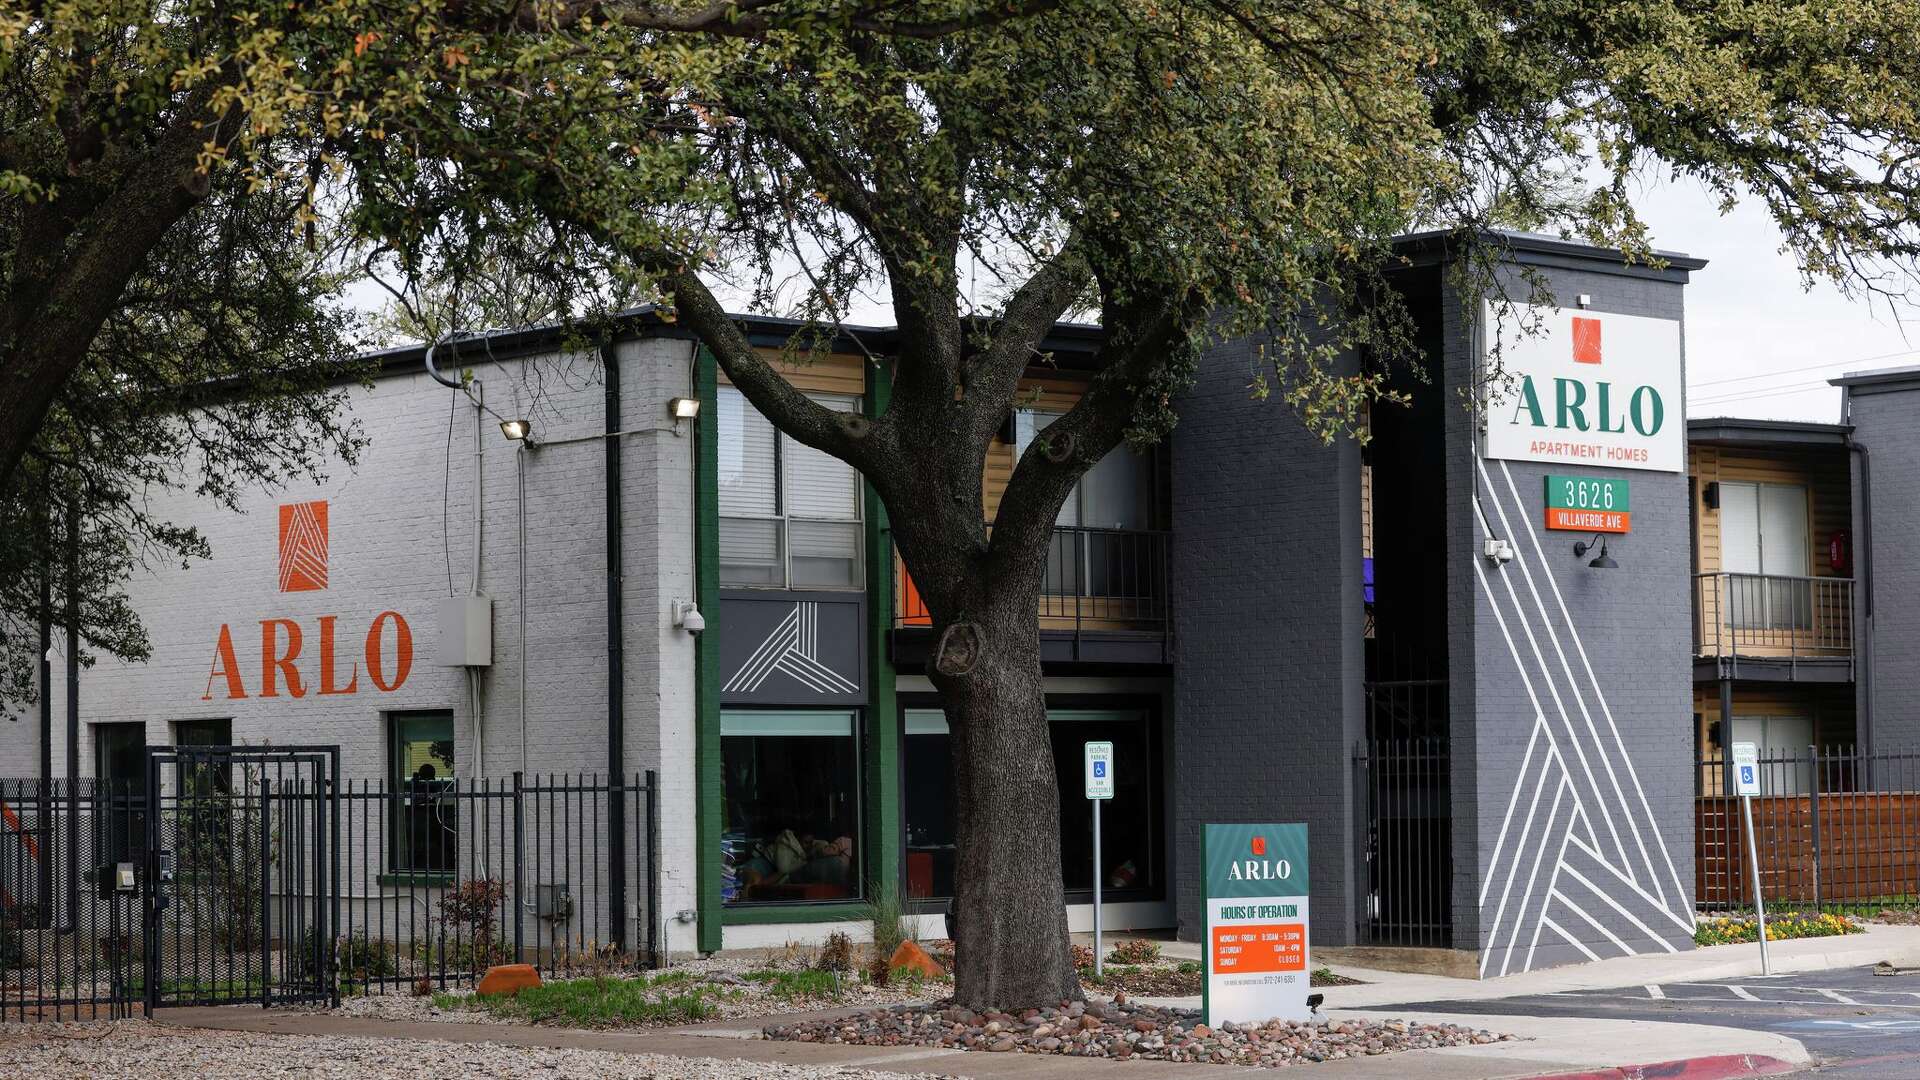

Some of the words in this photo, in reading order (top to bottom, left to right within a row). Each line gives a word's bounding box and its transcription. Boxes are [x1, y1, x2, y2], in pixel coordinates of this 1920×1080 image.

[1510, 374, 1664, 437] ARLO
[1530, 440, 1603, 458] APARTMENT
[1607, 446, 1648, 462] HOMES
[1565, 480, 1613, 509] 3626
[1558, 511, 1604, 528] VILLAVERDE
[1606, 514, 1622, 528] AVE
[201, 610, 413, 700] ARLO
[1228, 859, 1291, 881] ARLO
[1221, 906, 1246, 920] HOURS
[1247, 905, 1256, 919] OF
[1258, 904, 1298, 919] OPERATION
[1278, 954, 1300, 964] CLOSED
